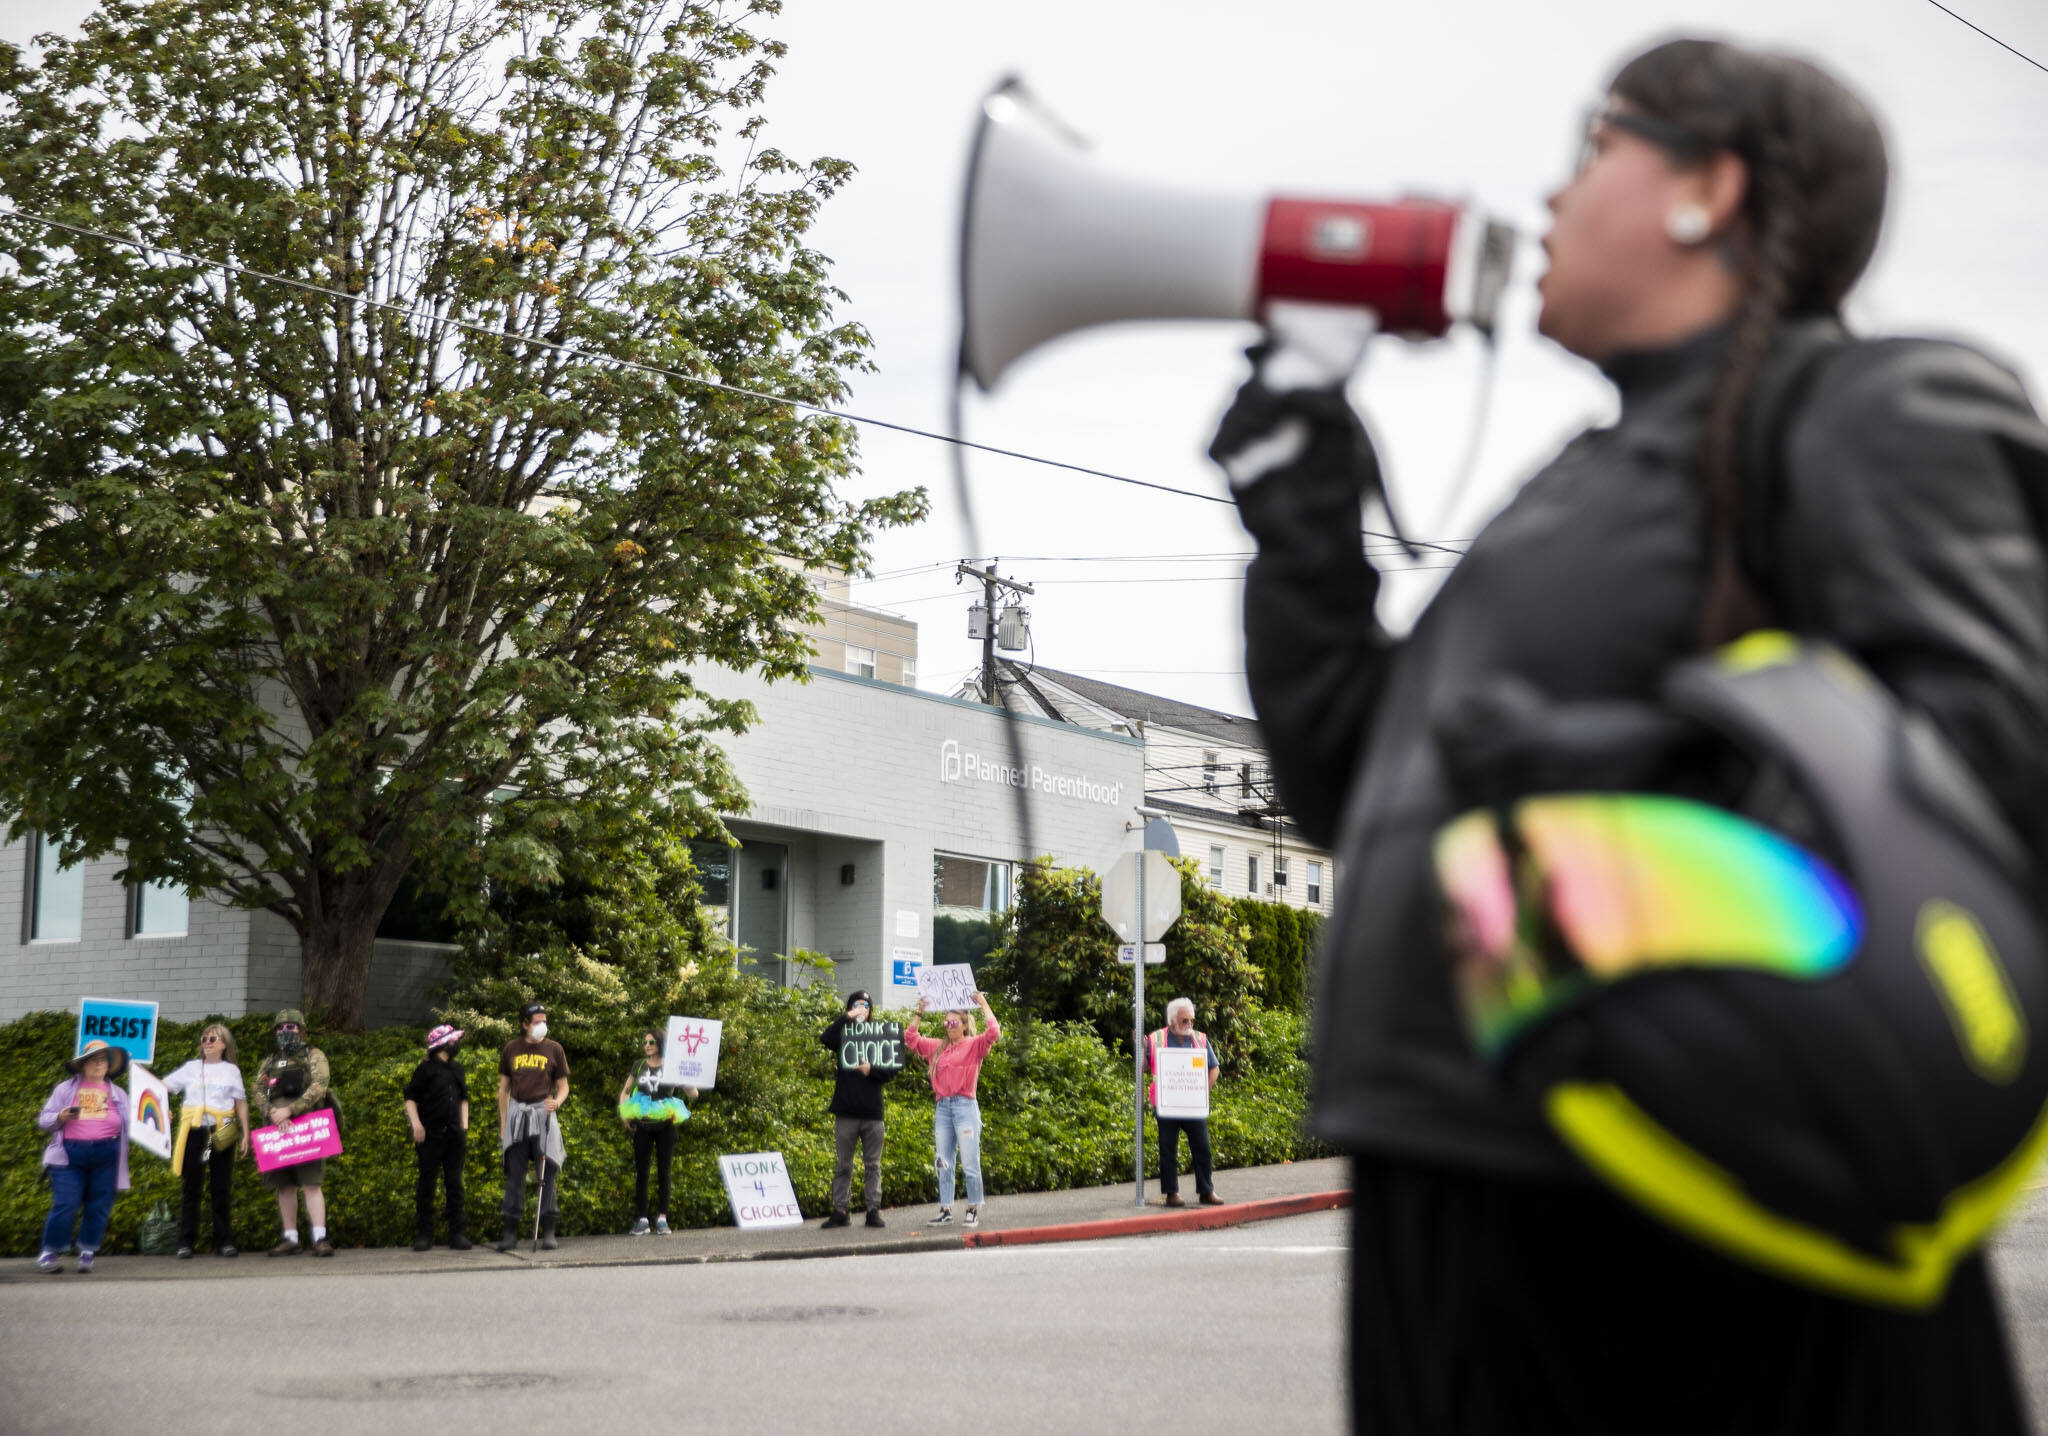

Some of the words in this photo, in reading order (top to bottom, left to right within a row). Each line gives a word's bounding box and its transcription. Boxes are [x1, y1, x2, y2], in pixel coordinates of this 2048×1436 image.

[964, 752, 1029, 789] Planned
[1032, 766, 1120, 806] Parenthood
[943, 968, 974, 988] GRL
[85, 1015, 152, 1039] RESIST
[844, 1022, 885, 1036] HONK
[891, 1022, 900, 1035] 4
[514, 1054, 548, 1070] PRATT
[842, 1040, 903, 1067] CHOICE
[310, 1117, 330, 1129] We
[263, 1138, 293, 1153] Fight
[294, 1134, 312, 1145] for
[313, 1128, 330, 1140] All
[731, 1160, 783, 1176] HONK
[740, 1204, 800, 1221] CHOICE
